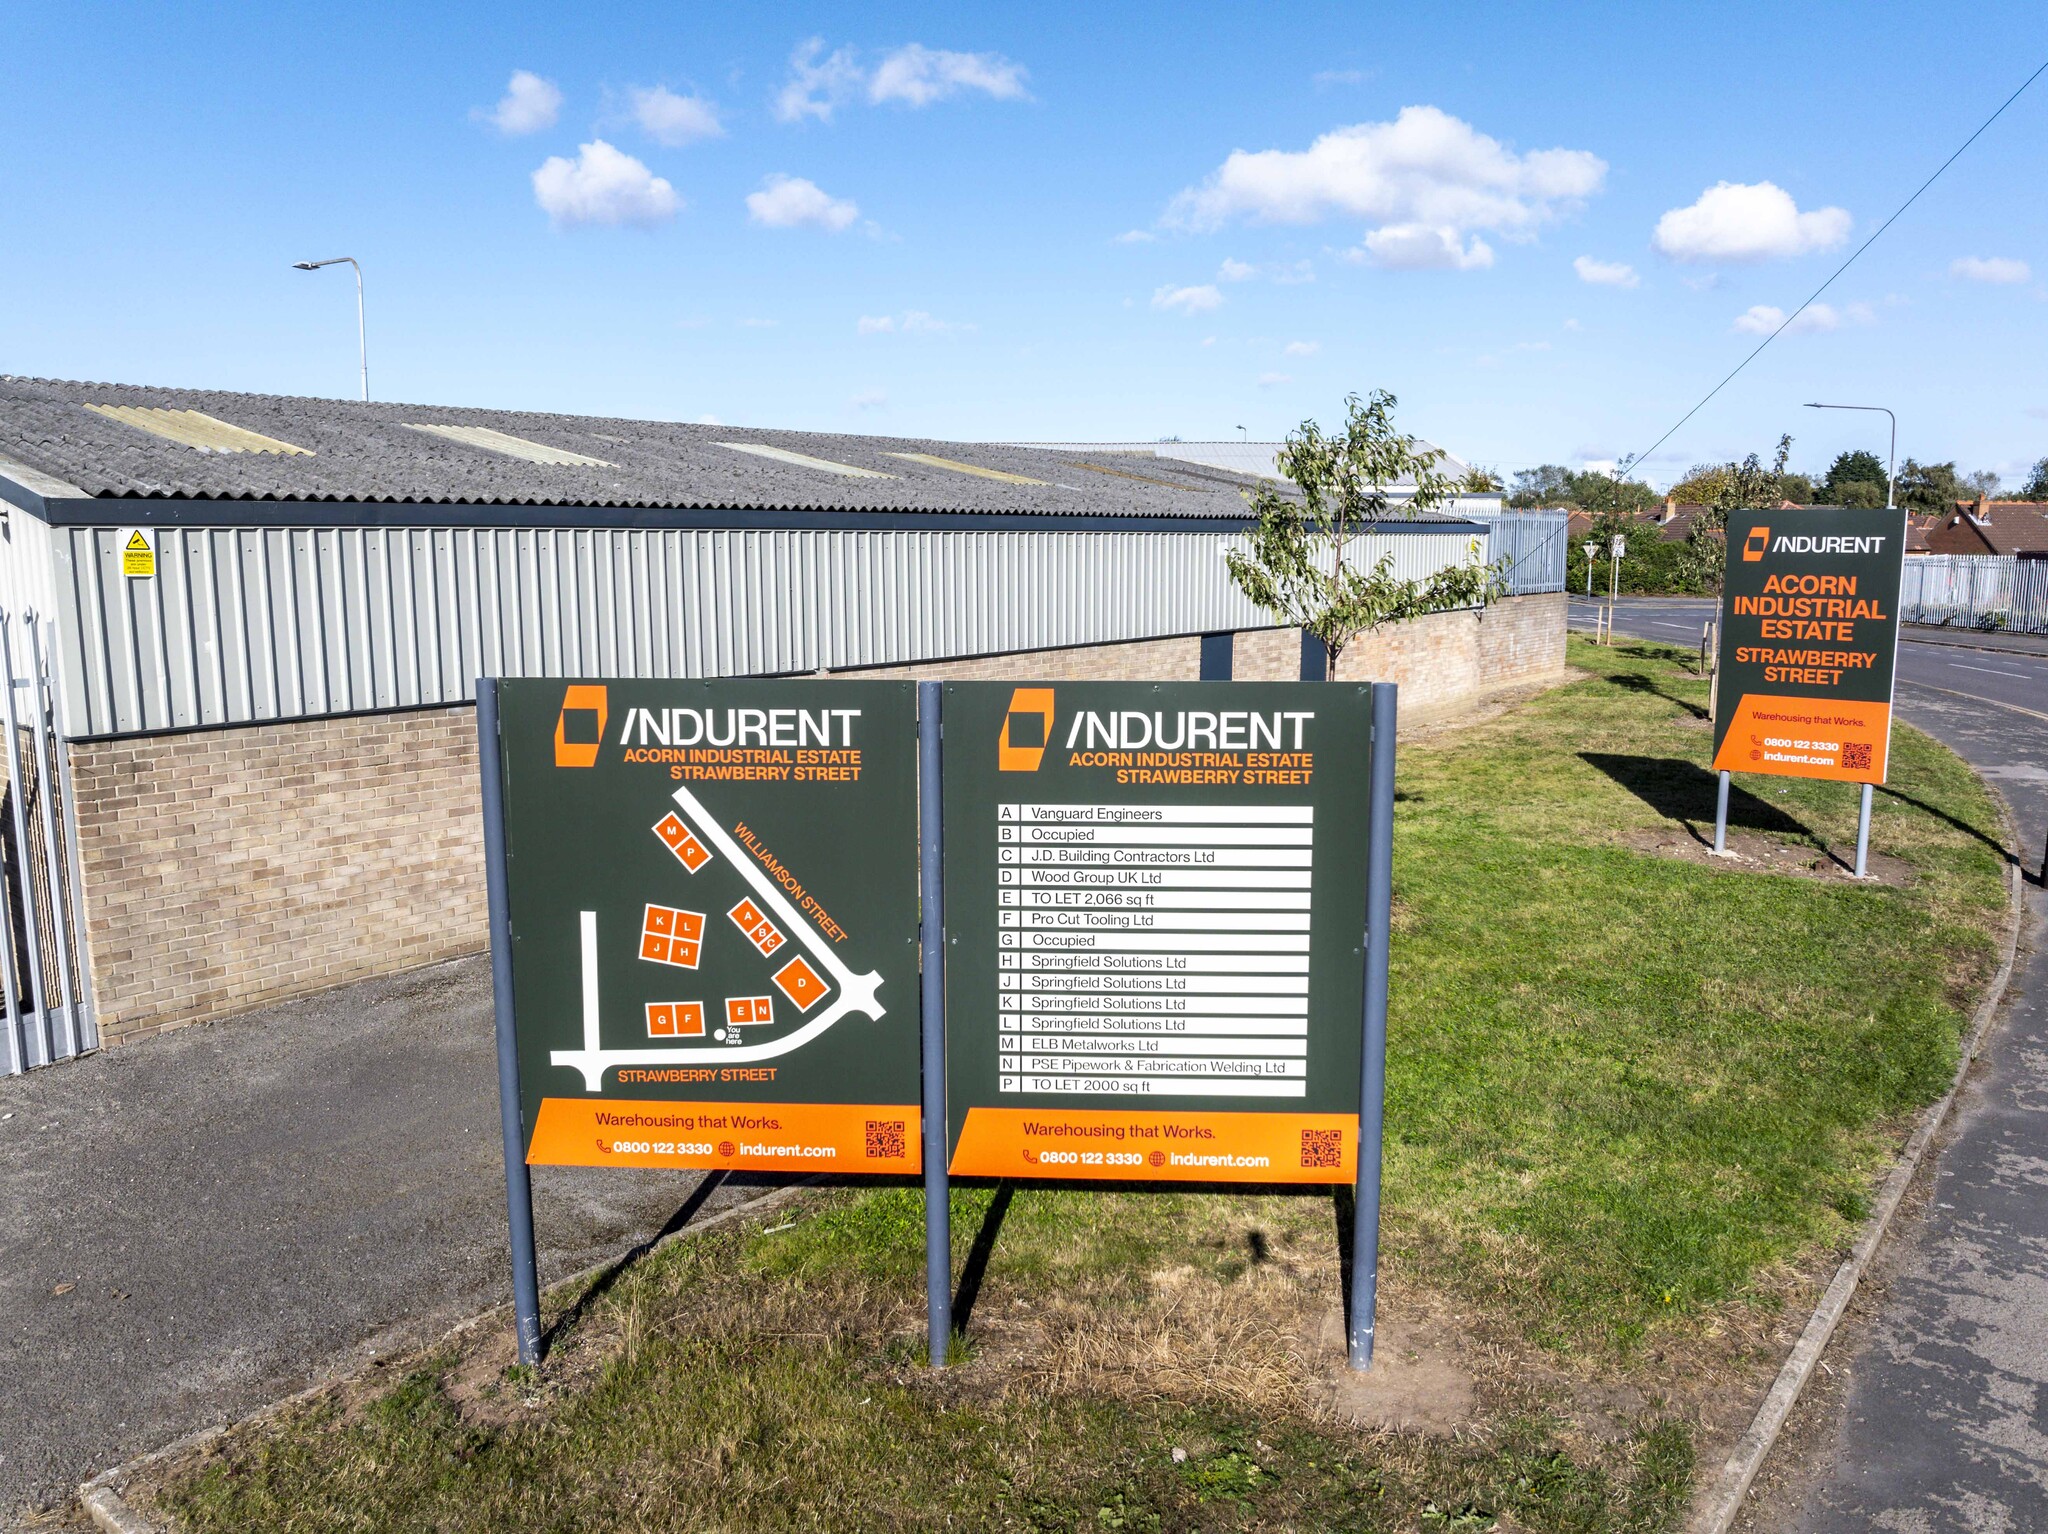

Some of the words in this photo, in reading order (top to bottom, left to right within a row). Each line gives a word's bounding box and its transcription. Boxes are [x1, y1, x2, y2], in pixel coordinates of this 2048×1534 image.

[1763, 575, 1856, 595] ACORN
[1734, 597, 1886, 619] INDUSTRIAL
[1761, 620, 1854, 641] ESTATE
[1736, 647, 1876, 668] STRAWBERRY
[1764, 666, 1843, 685] STREET
[1753, 712, 1811, 724] Warehousing
[1814, 716, 1831, 724] that
[1834, 717, 1866, 727] Works.
[1764, 738, 1791, 748] 0800
[1793, 739, 1809, 749] 122
[1811, 741, 1839, 751] 3330
[624, 749, 686, 763] ACORN
[689, 749, 793, 764] INDUSTRIAL
[797, 750, 861, 765] ESTATE
[1069, 752, 1133, 766] ACORN
[1137, 752, 1243, 767] INDUSTRIAL
[1247, 753, 1312, 767] ESTATE
[1764, 751, 1834, 766] indurent.com
[670, 766, 790, 780] STRAWBERRY
[794, 767, 861, 781] STREET
[1116, 770, 1239, 784] STRAWBERRY
[1244, 770, 1312, 785] STREET
[1001, 807, 1012, 819] A
[1031, 808, 1094, 822] Vanguard
[1097, 808, 1162, 822] Engineers
[667, 827, 676, 835] M
[1002, 828, 1012, 840] B
[1031, 828, 1095, 843] Occupied
[688, 848, 694, 856] P
[1001, 850, 1013, 861] C
[1031, 850, 1055, 862] J.D.
[1059, 850, 1109, 865] Building
[1113, 850, 1190, 863] Contractors
[1194, 851, 1215, 863] Ltd
[734, 822, 806, 900] WILLIAMSON
[801, 896, 848, 943] STREET
[1002, 871, 1012, 882] D
[1032, 871, 1070, 883] Wood
[1073, 871, 1114, 886] Group
[1118, 872, 1137, 883] UK
[1141, 872, 1161, 884] Ltd
[1003, 892, 1011, 903] E
[1032, 892, 1050, 904] TO
[1054, 893, 1082, 904] LET
[1084, 893, 1122, 906] 2,066
[1125, 895, 1142, 909] sq
[1144, 893, 1154, 905] ft
[656, 917, 664, 925] K
[744, 912, 752, 920] A
[1003, 914, 1011, 924] F
[1032, 914, 1054, 925] Pro
[1057, 914, 1080, 925] Cut
[1084, 914, 1129, 928] Tooling
[1133, 914, 1153, 925] Ltd
[684, 923, 691, 931] L
[767, 939, 775, 947] C
[1001, 934, 1013, 946] G
[1032, 934, 1095, 948] Occupied
[681, 948, 688, 956] H
[1002, 955, 1013, 967] H
[1032, 955, 1101, 970] Springfield
[1103, 956, 1163, 968] Solutions
[1166, 957, 1186, 969] Ltd
[1003, 976, 1013, 988] J
[1032, 976, 1101, 991] Springfield
[1103, 977, 1163, 989] Solutions
[1166, 978, 1186, 989] Ltd
[738, 1007, 744, 1015] E
[1002, 997, 1013, 1008] K
[1032, 997, 1101, 1012] Springfield
[1103, 998, 1163, 1010] Solutions
[1166, 999, 1186, 1010] Ltd
[658, 1016, 666, 1024] G
[1002, 1018, 1013, 1029] L
[1032, 1018, 1101, 1032] Springfield
[1103, 1019, 1163, 1031] Solutions
[1166, 1020, 1186, 1031] Ltd
[1001, 1038, 1014, 1049] M
[1032, 1039, 1058, 1050] ELB
[1062, 1039, 1135, 1051] Metalworks
[1138, 1040, 1158, 1051] Ltd
[618, 1069, 717, 1082] STRAWBERRY
[721, 1068, 777, 1081] STREET
[1003, 1059, 1013, 1069] N
[1032, 1059, 1058, 1071] PSE
[1063, 1059, 1121, 1073] Pipework
[1124, 1060, 1134, 1071] &
[1137, 1060, 1207, 1072] Fabrication
[1210, 1061, 1262, 1076] Welding
[1265, 1062, 1285, 1073] Ltd
[1004, 1080, 1012, 1090] P
[1032, 1080, 1051, 1091] TO
[1055, 1080, 1080, 1091] LET
[1084, 1080, 1119, 1091] 2000
[1123, 1082, 1138, 1095] sq
[1141, 1080, 1150, 1091] ft
[596, 1113, 695, 1130] Warehousing
[698, 1115, 728, 1128] that
[731, 1116, 783, 1130] Works.
[1023, 1123, 1125, 1140] Warehousing
[1129, 1125, 1160, 1138] that
[1163, 1125, 1216, 1139] Works.
[613, 1141, 650, 1154] 0800
[652, 1143, 674, 1154] 122
[677, 1143, 712, 1155] 3330
[740, 1143, 836, 1158] indurent.com
[1040, 1152, 1078, 1165] 0800
[1080, 1153, 1103, 1165] 122
[1106, 1153, 1142, 1165] 3330
[1170, 1152, 1270, 1168] indurent.com
